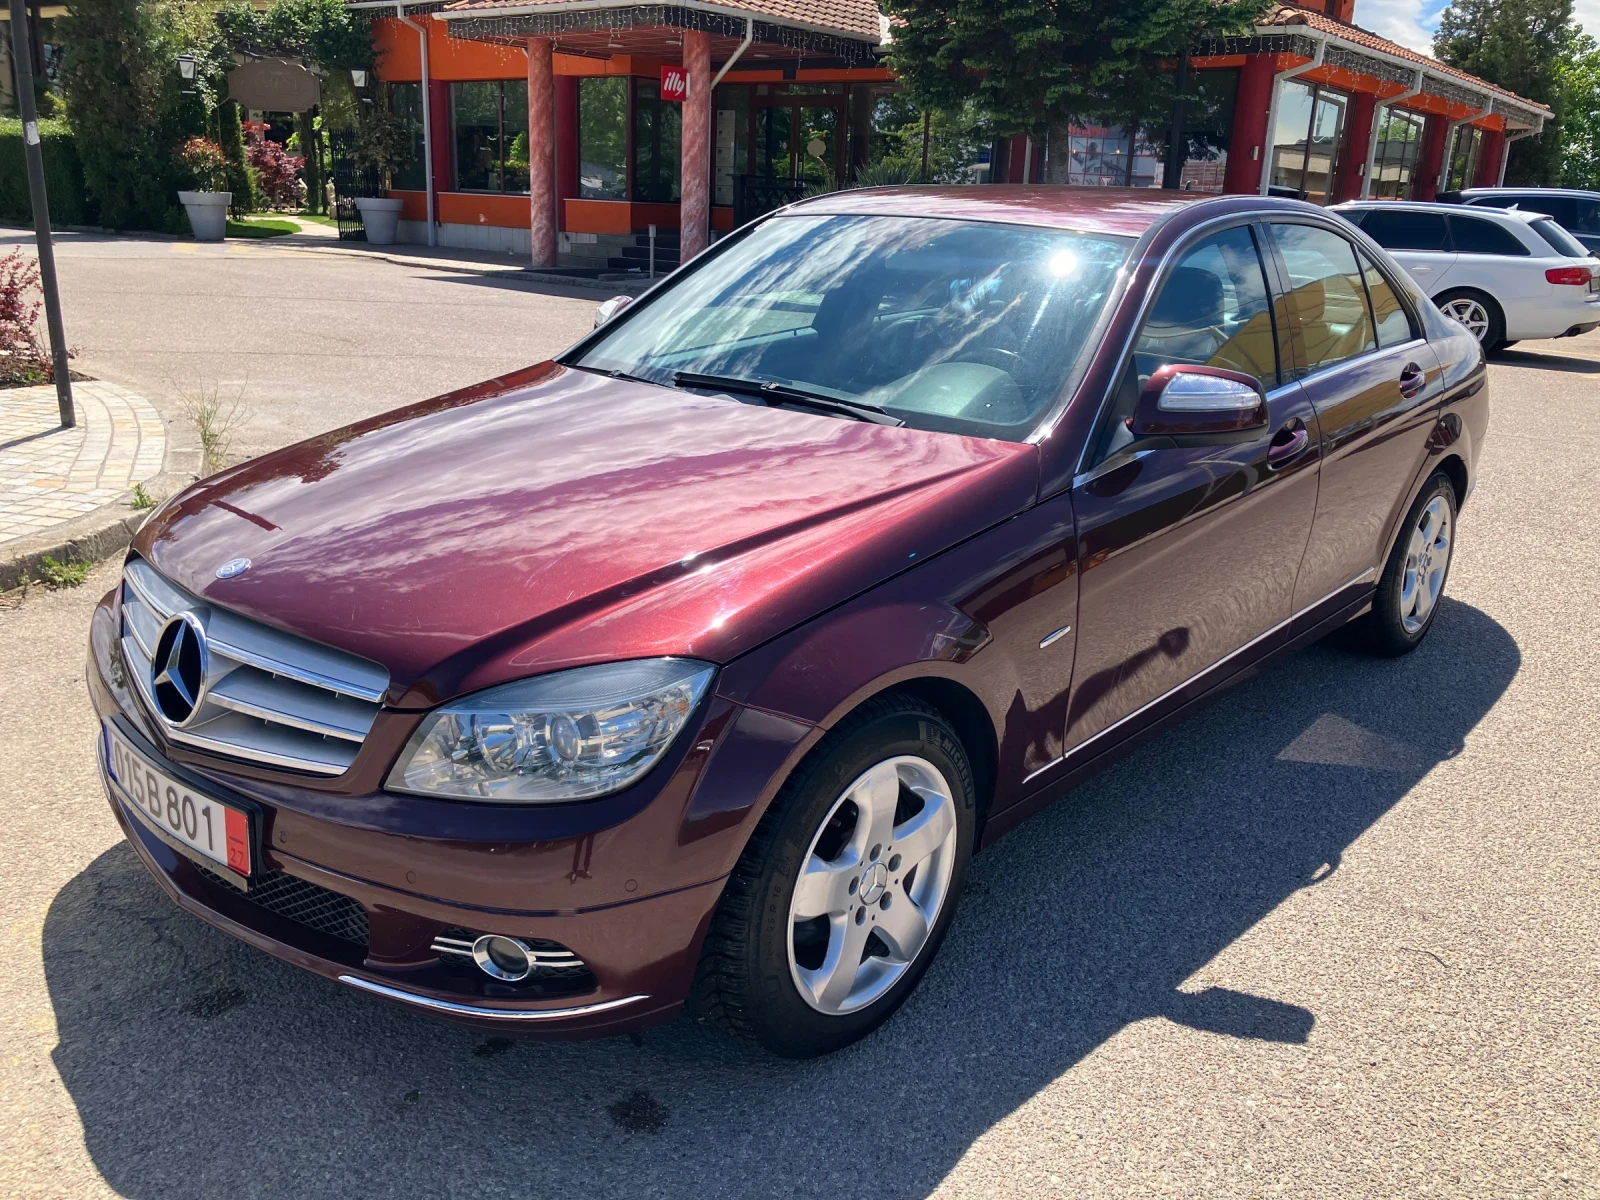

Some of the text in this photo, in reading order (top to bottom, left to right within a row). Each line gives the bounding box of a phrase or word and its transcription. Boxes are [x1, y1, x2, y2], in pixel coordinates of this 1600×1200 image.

[664, 72, 685, 96] illy
[941, 738, 973, 806] MICHELIN
[230, 848, 243, 866] 27
